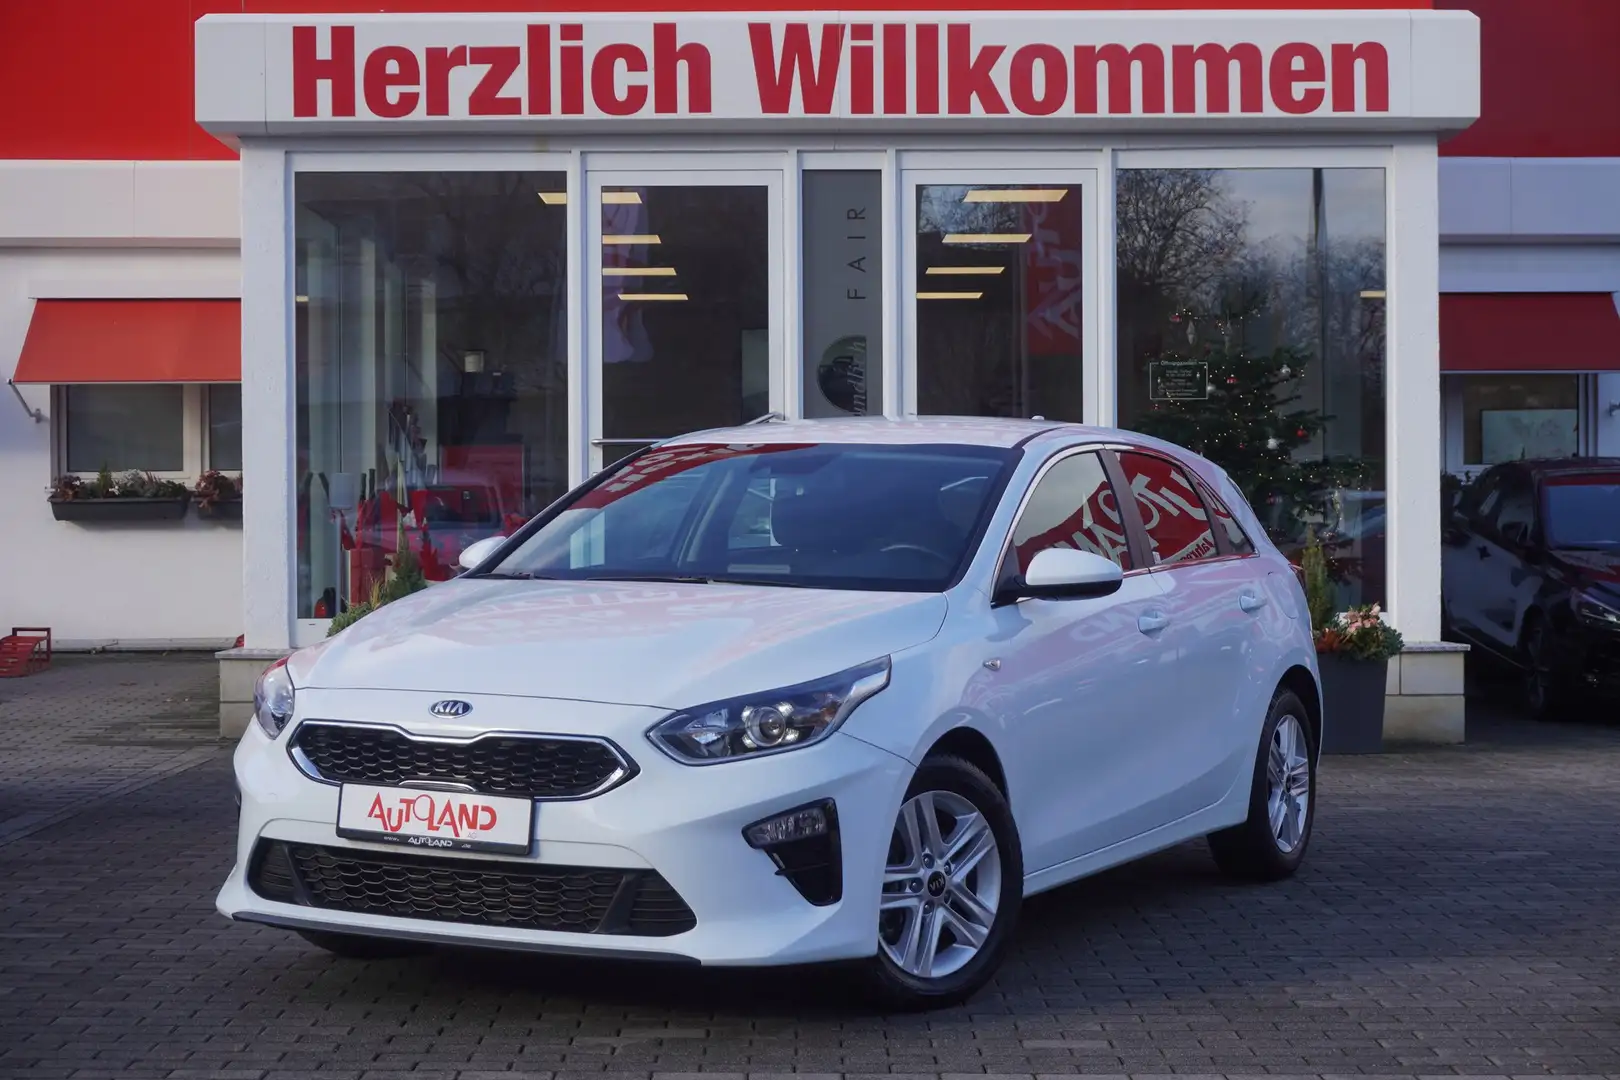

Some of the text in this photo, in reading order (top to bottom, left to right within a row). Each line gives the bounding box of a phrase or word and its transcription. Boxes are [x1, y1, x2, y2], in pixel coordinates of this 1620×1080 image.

[293, 23, 1389, 119] Herzlich Willkommen
[847, 206, 866, 300] FAIR
[433, 701, 465, 714] KIA
[368, 792, 497, 838] AUTOLAND
[407, 836, 453, 848] AUTOLAND
